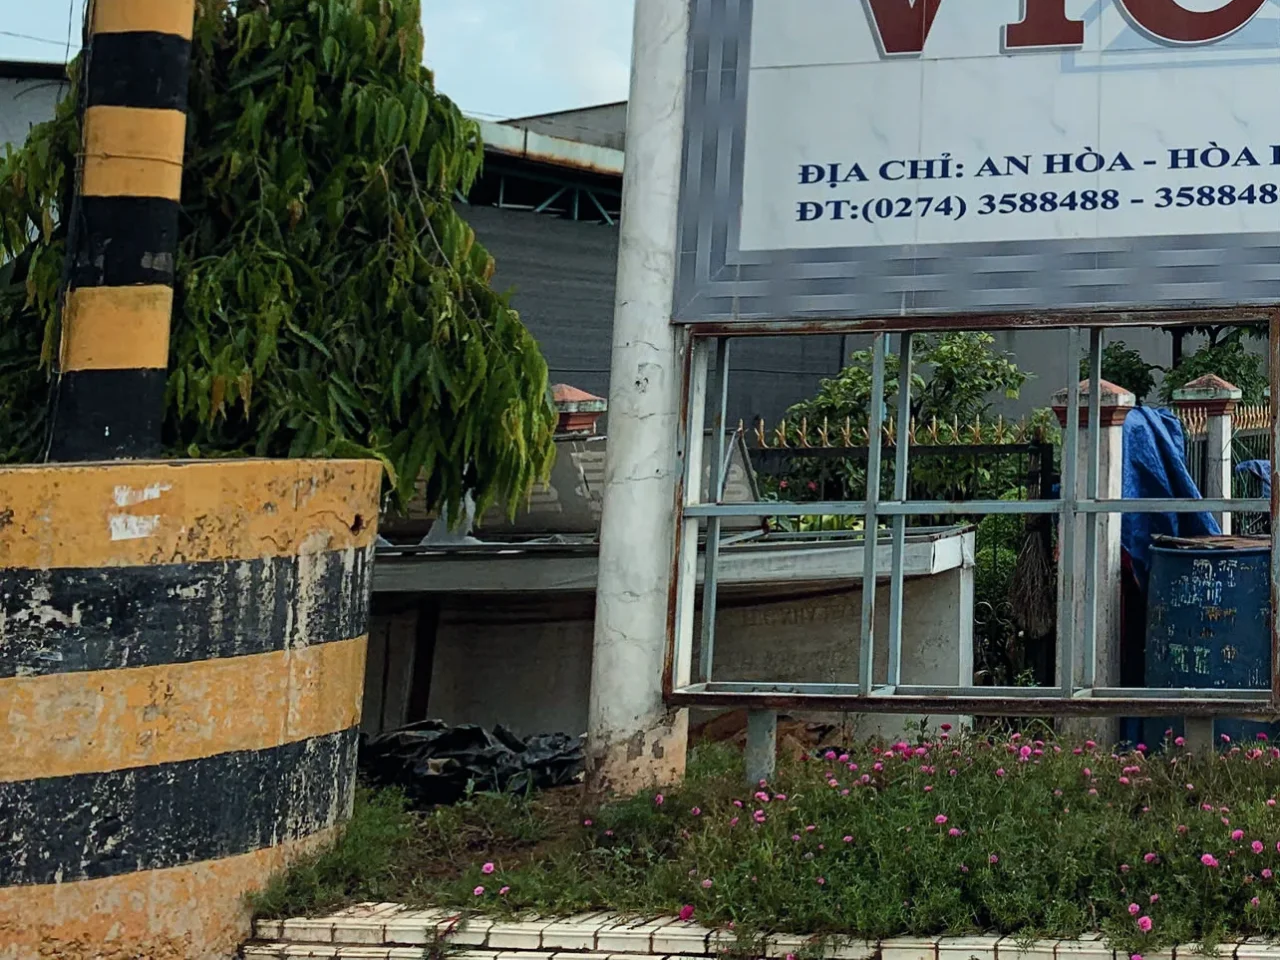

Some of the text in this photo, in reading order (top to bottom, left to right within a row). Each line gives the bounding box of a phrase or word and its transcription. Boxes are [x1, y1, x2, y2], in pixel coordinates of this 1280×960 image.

[797, 162, 869, 188] ĐỊA
[879, 152, 965, 180] CHỈ:
[974, 154, 1032, 178] AN
[1042, 146, 1134, 175] HÒA
[1166, 142, 1261, 170] HÒA
[977, 189, 1121, 216] 3588488
